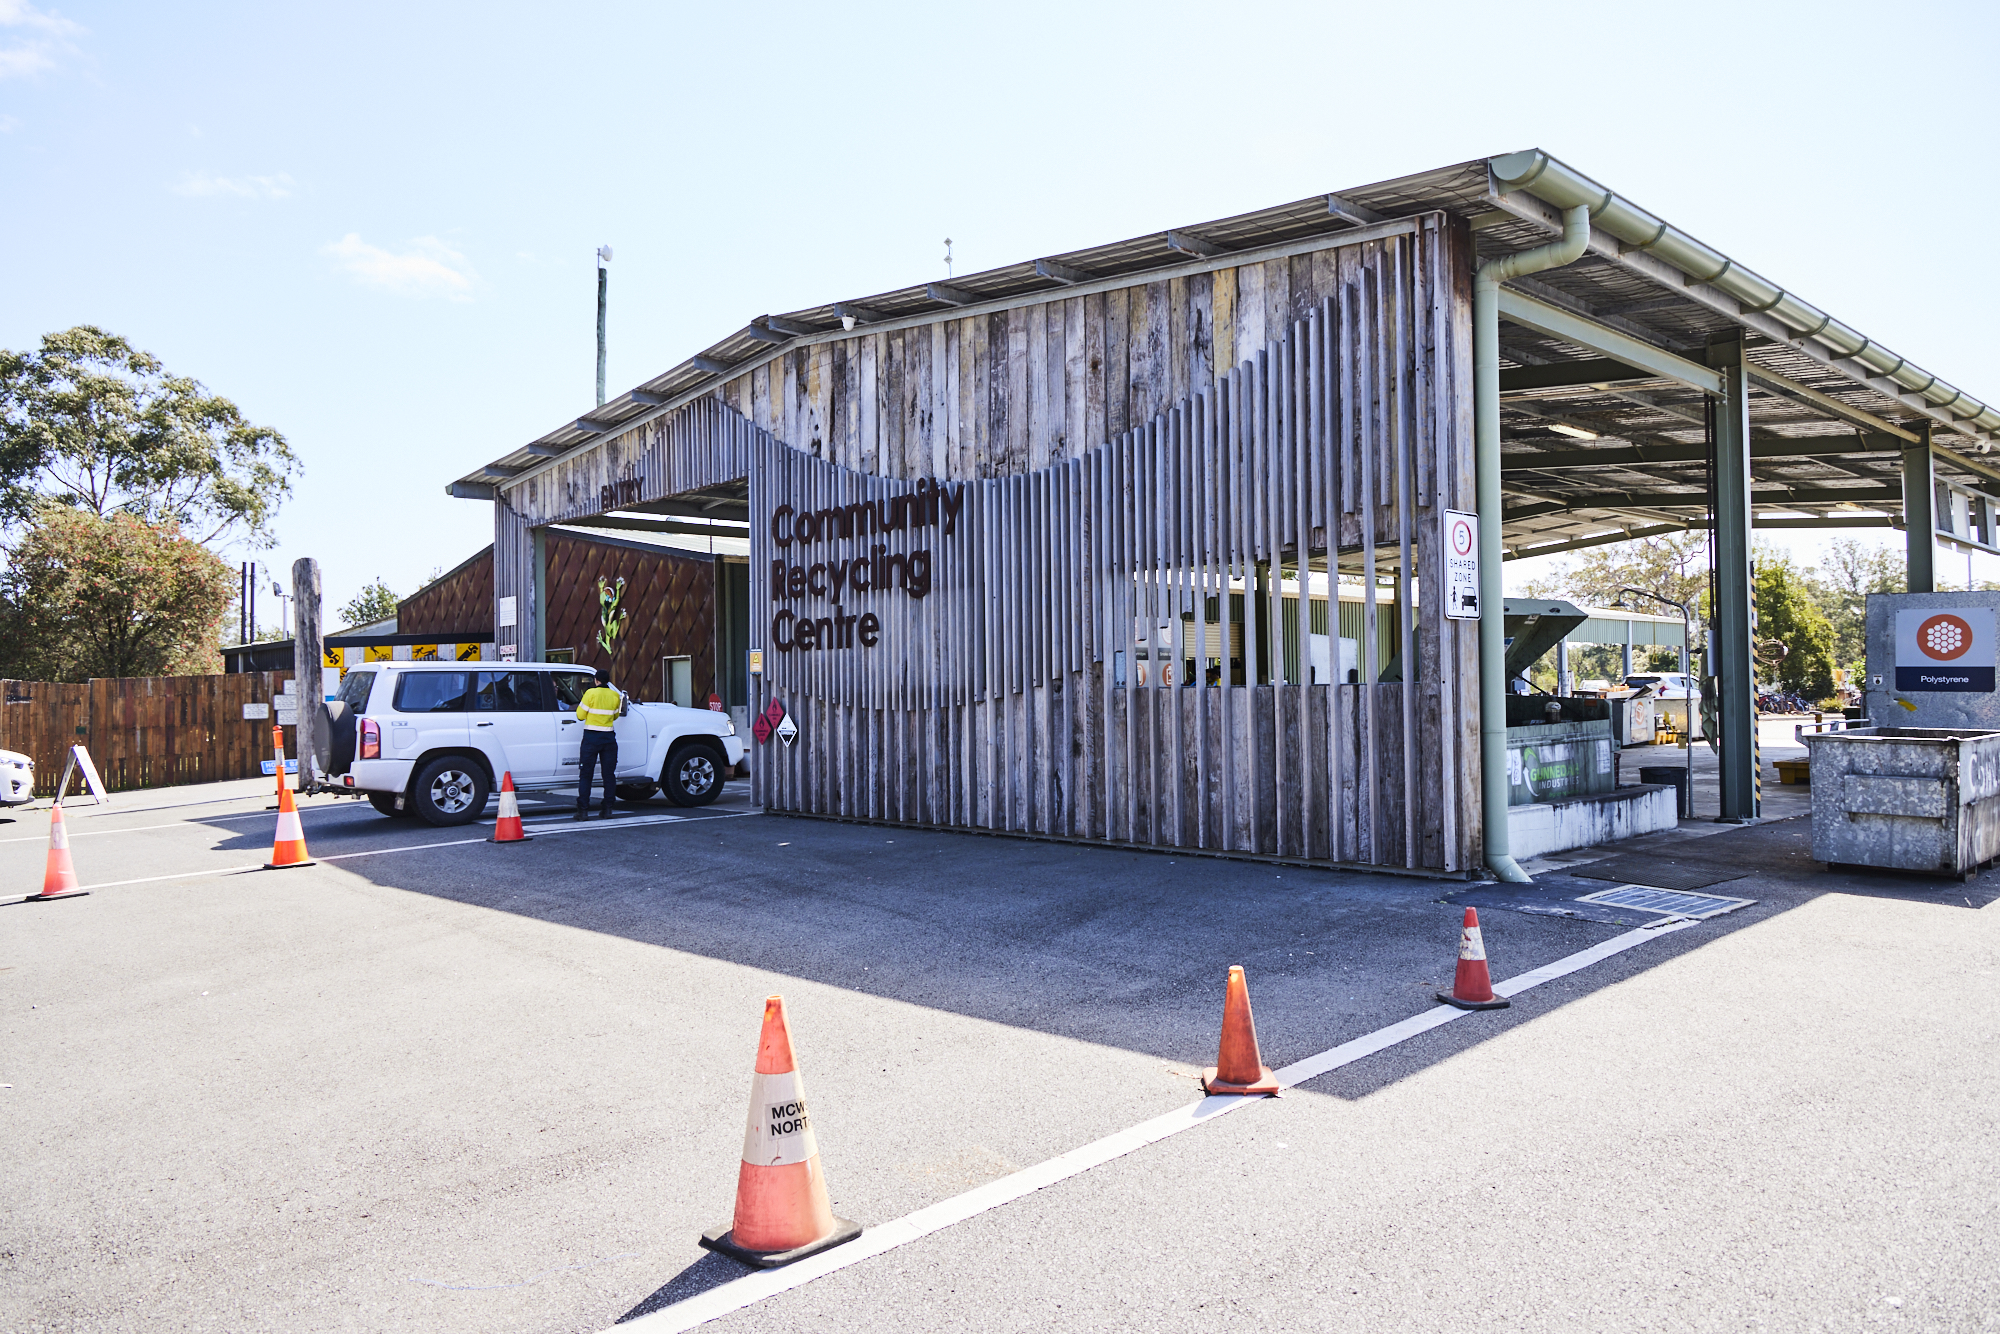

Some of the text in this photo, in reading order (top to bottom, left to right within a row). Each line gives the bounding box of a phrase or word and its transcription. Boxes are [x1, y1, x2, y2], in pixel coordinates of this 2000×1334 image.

[601, 476, 644, 510] ENTRY
[772, 477, 965, 547] Community
[1459, 530, 1465, 545] 5
[1449, 558, 1476, 571] SHARED
[772, 544, 931, 604] Recycling
[1454, 571, 1472, 583] ZONE
[772, 605, 879, 652] Centre
[1920, 675, 1970, 685] Polystyrene
[709, 701, 722, 711] STOP
[1539, 776, 1579, 790] INDUSTRIES
